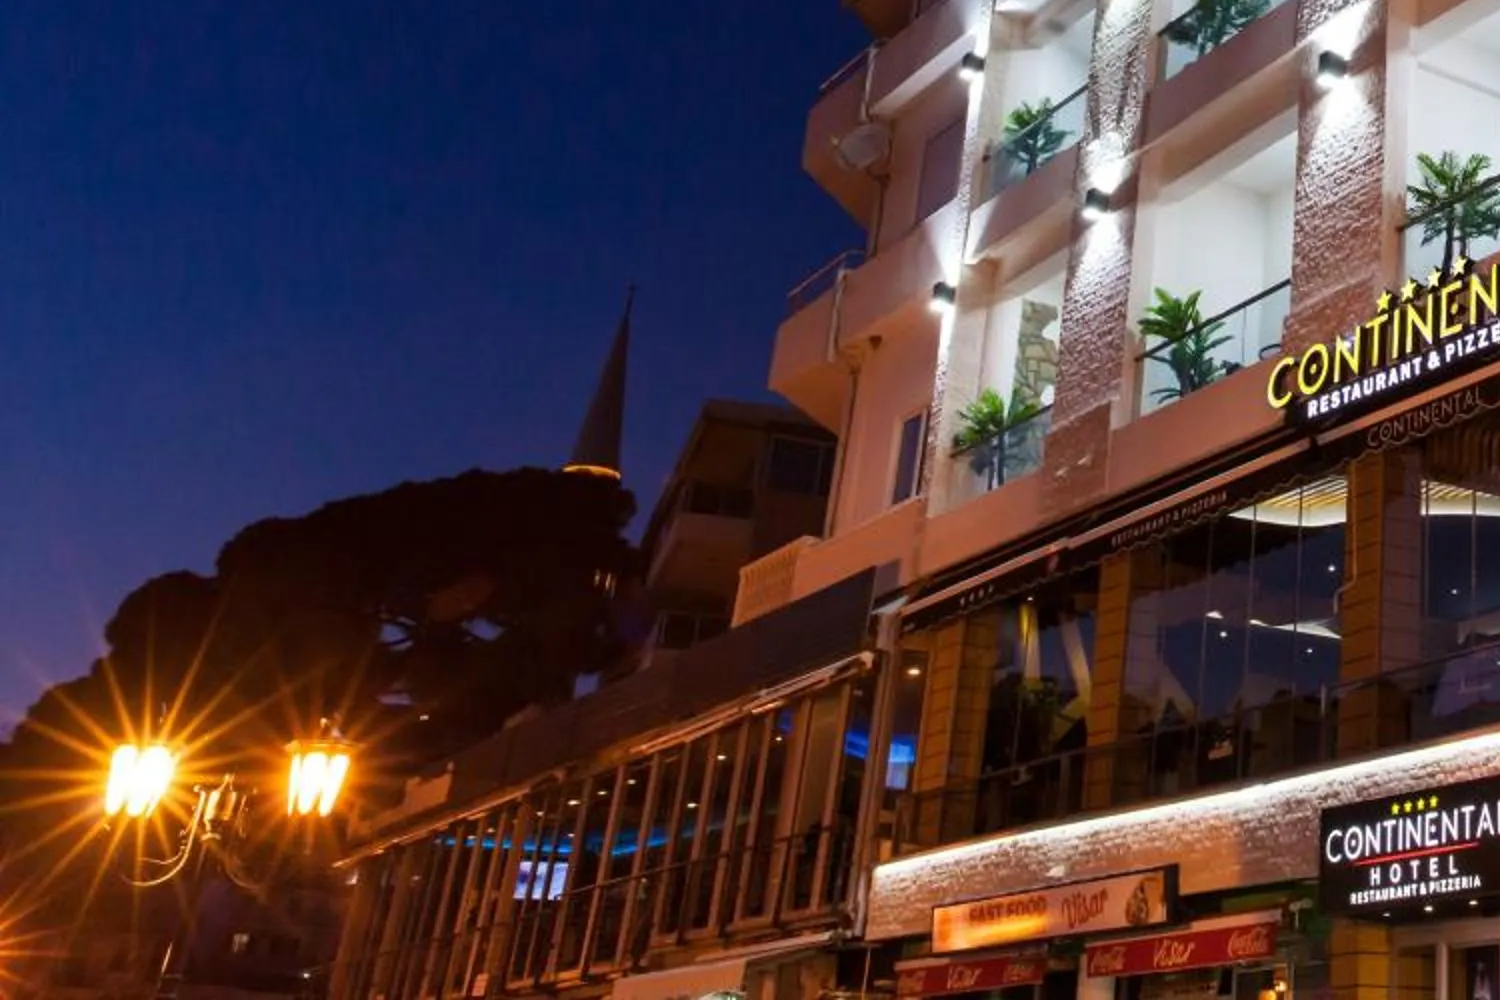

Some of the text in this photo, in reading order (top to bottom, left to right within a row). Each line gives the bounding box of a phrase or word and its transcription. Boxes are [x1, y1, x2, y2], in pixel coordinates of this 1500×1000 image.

[1307, 356, 1423, 419] RESTAURANT
[1427, 350, 1441, 371] &
[1367, 386, 1484, 447] CONTINENTAL
[1370, 855, 1459, 886] HOTEL
[1350, 884, 1419, 905] RESTAURANT
[1429, 875, 1481, 895] PIZZERIA
[968, 902, 1003, 924] FAST
